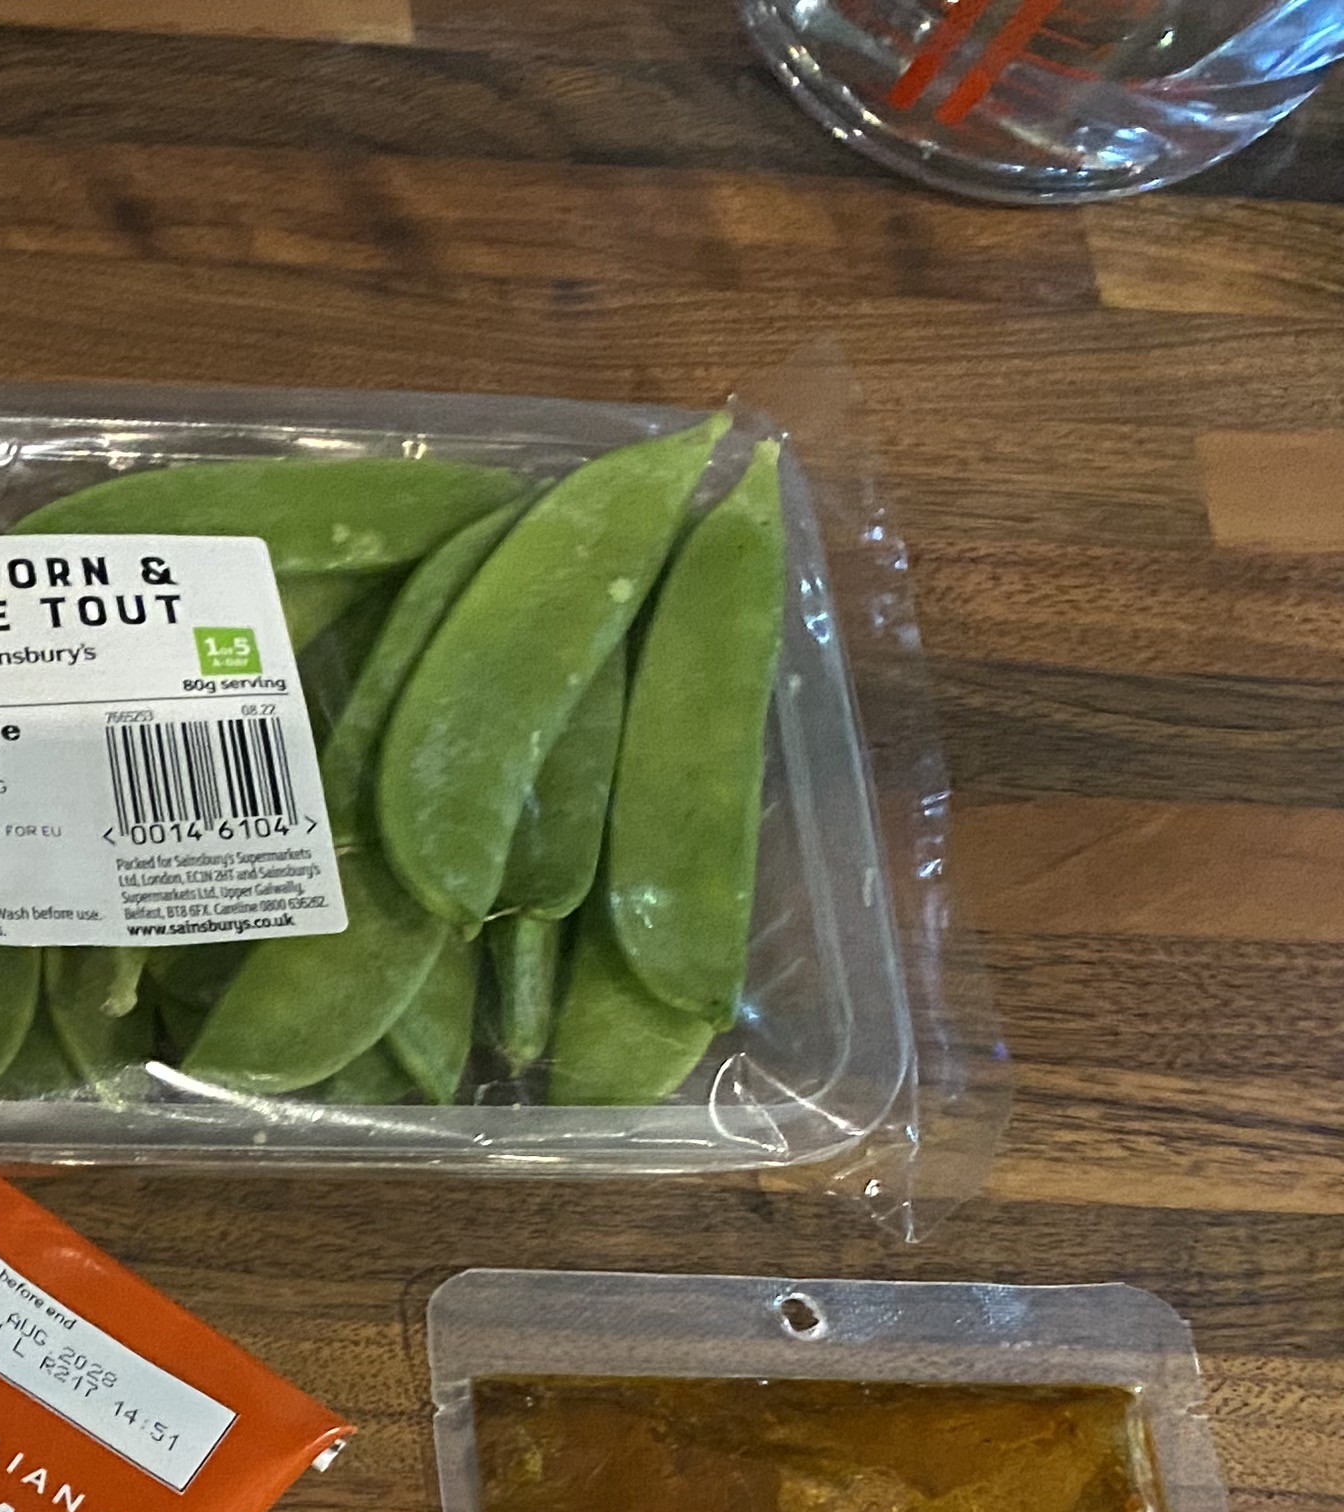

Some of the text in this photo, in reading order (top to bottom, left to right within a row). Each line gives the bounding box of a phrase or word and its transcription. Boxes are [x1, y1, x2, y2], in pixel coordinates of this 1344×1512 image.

[141, 556, 178, 584] &
[40, 595, 181, 628] TOUT
[183, 676, 287, 693] 80g serving
[5, 825, 37, 837] FOR
[41, 825, 62, 837] EU
[116, 848, 311, 870] Packed for Sainsbury's Supermarkets
[237, 866, 258, 880] and
[259, 864, 321, 879] Sainsbury's
[122, 886, 252, 904] Supermarkets Upper
[31, 907, 74, 921] before
[127, 913, 295, 936] www.sainsburys.co.uk
[46, 1305, 78, 1330] end
[6, 1312, 49, 1347] AUG
[12, 1336, 25, 1359] L
